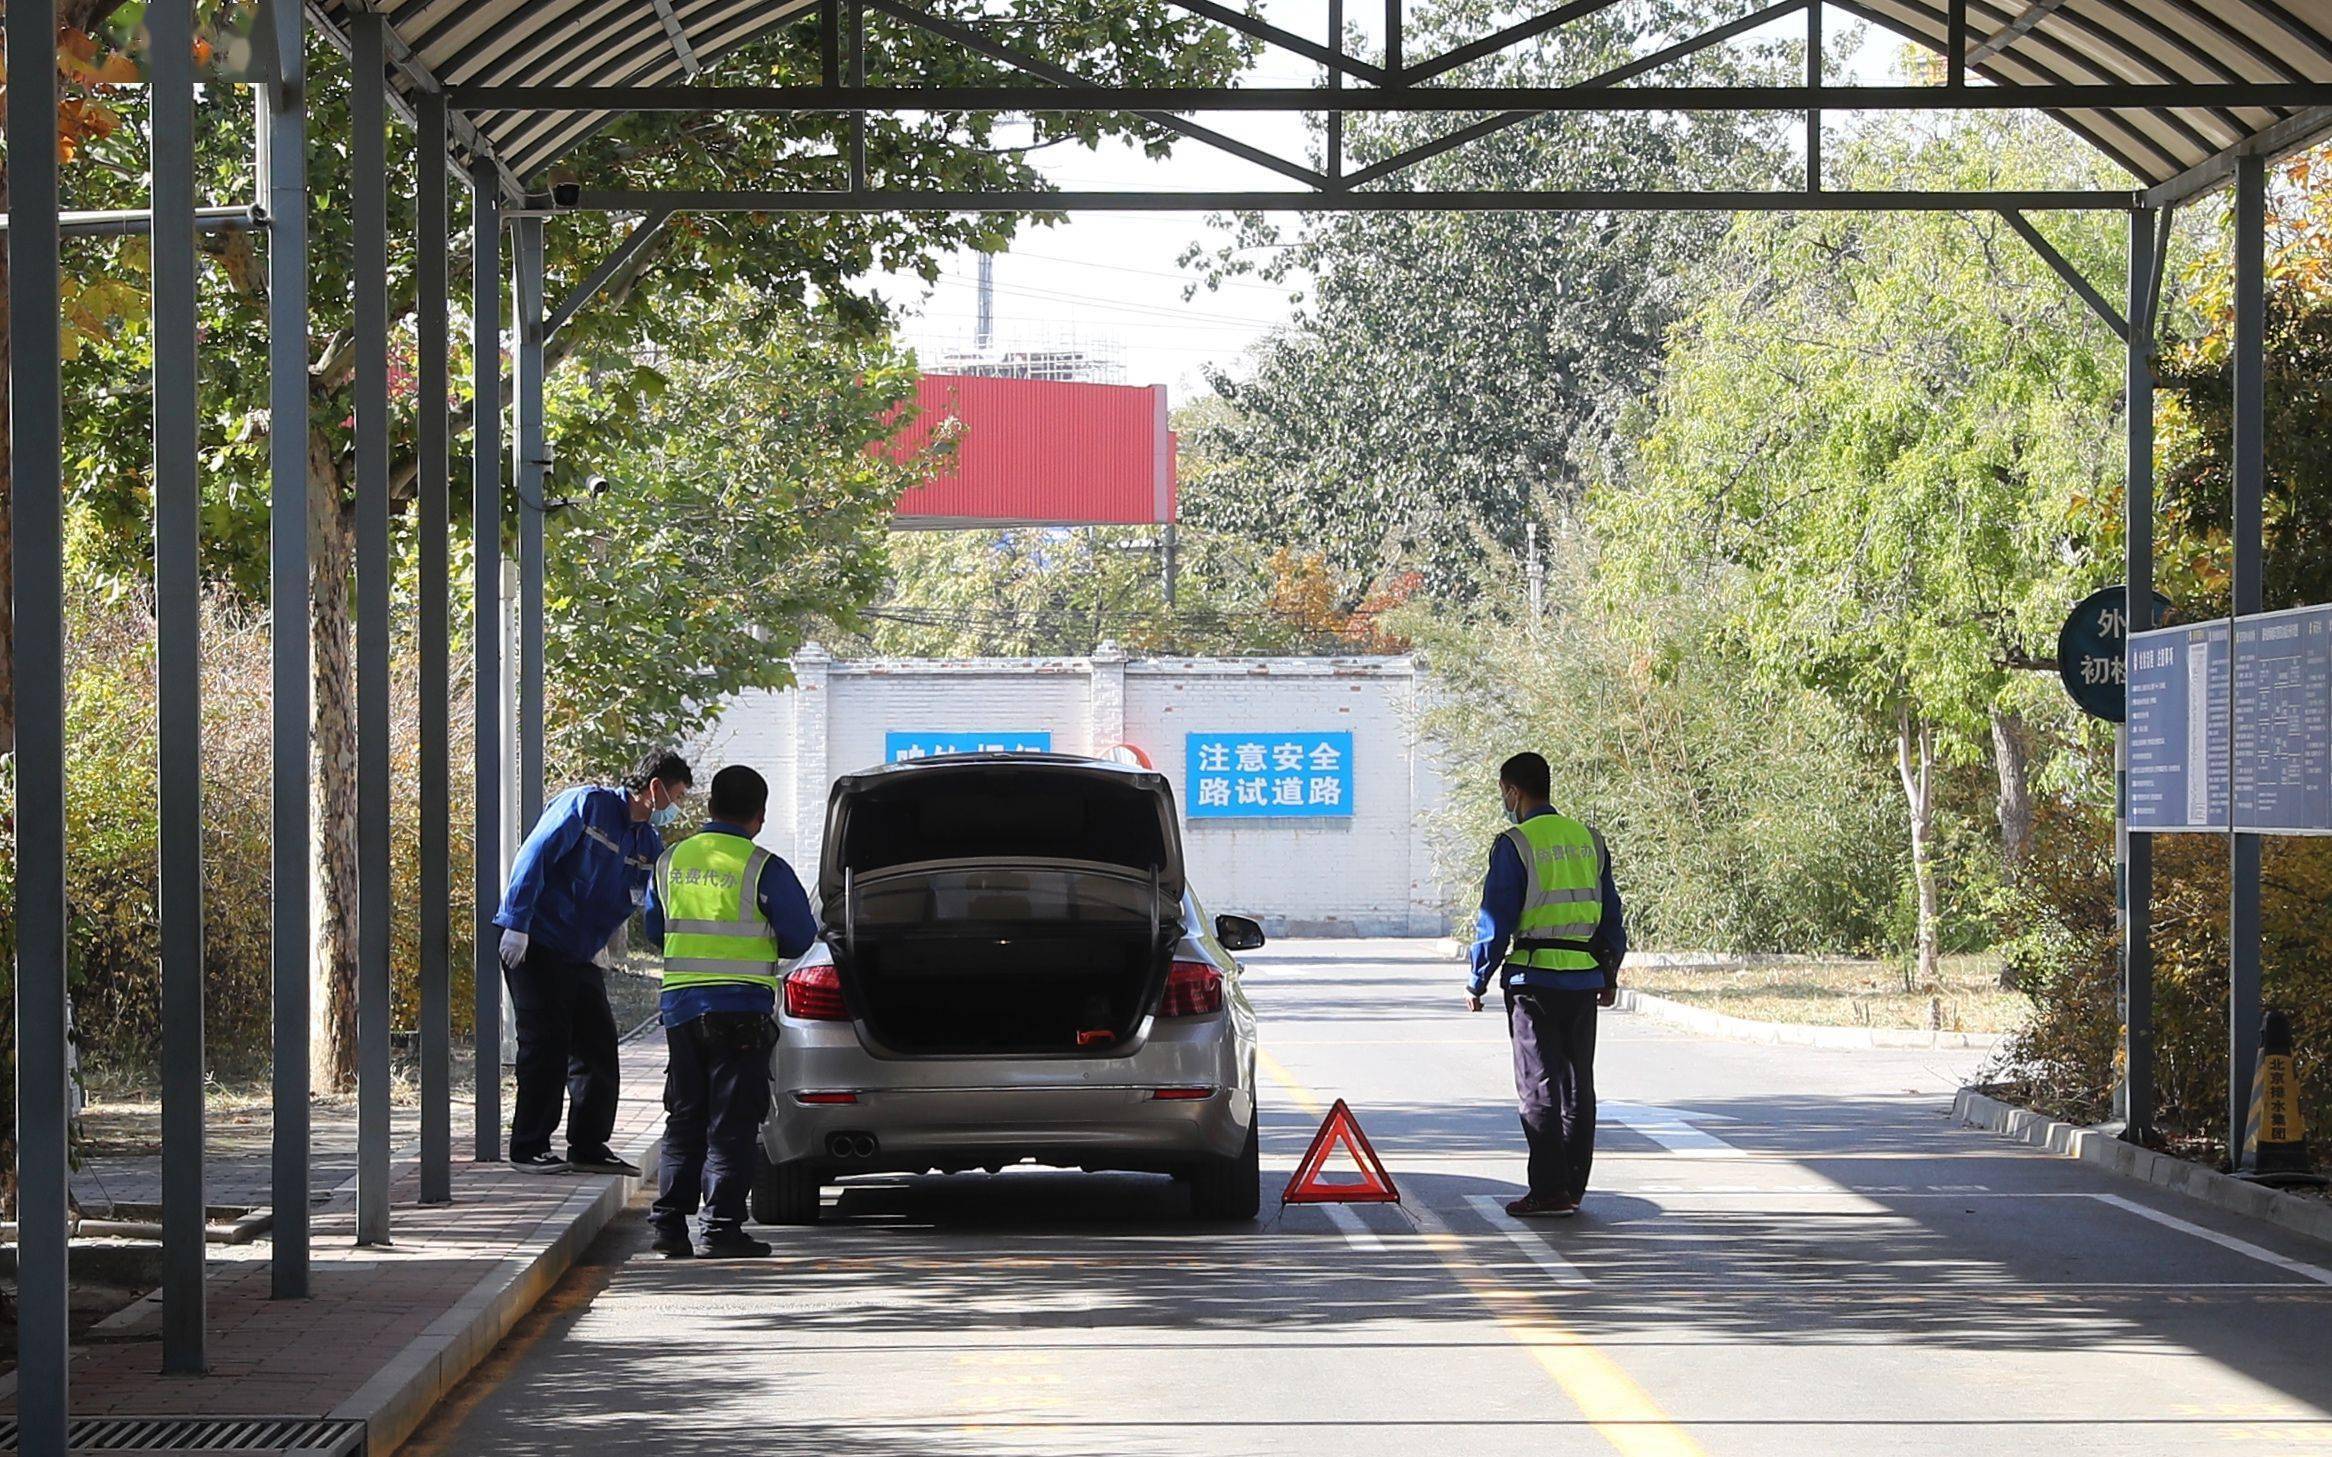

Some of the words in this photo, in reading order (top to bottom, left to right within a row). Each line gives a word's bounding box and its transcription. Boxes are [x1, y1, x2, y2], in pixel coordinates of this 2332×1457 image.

[2097, 608, 2127, 638] 外
[1198, 742, 1341, 772] 注意安全
[1198, 776, 1342, 807] 路试道路
[669, 868, 738, 889] 免费代办
[2270, 1057, 2286, 1139] 北京排水集团
